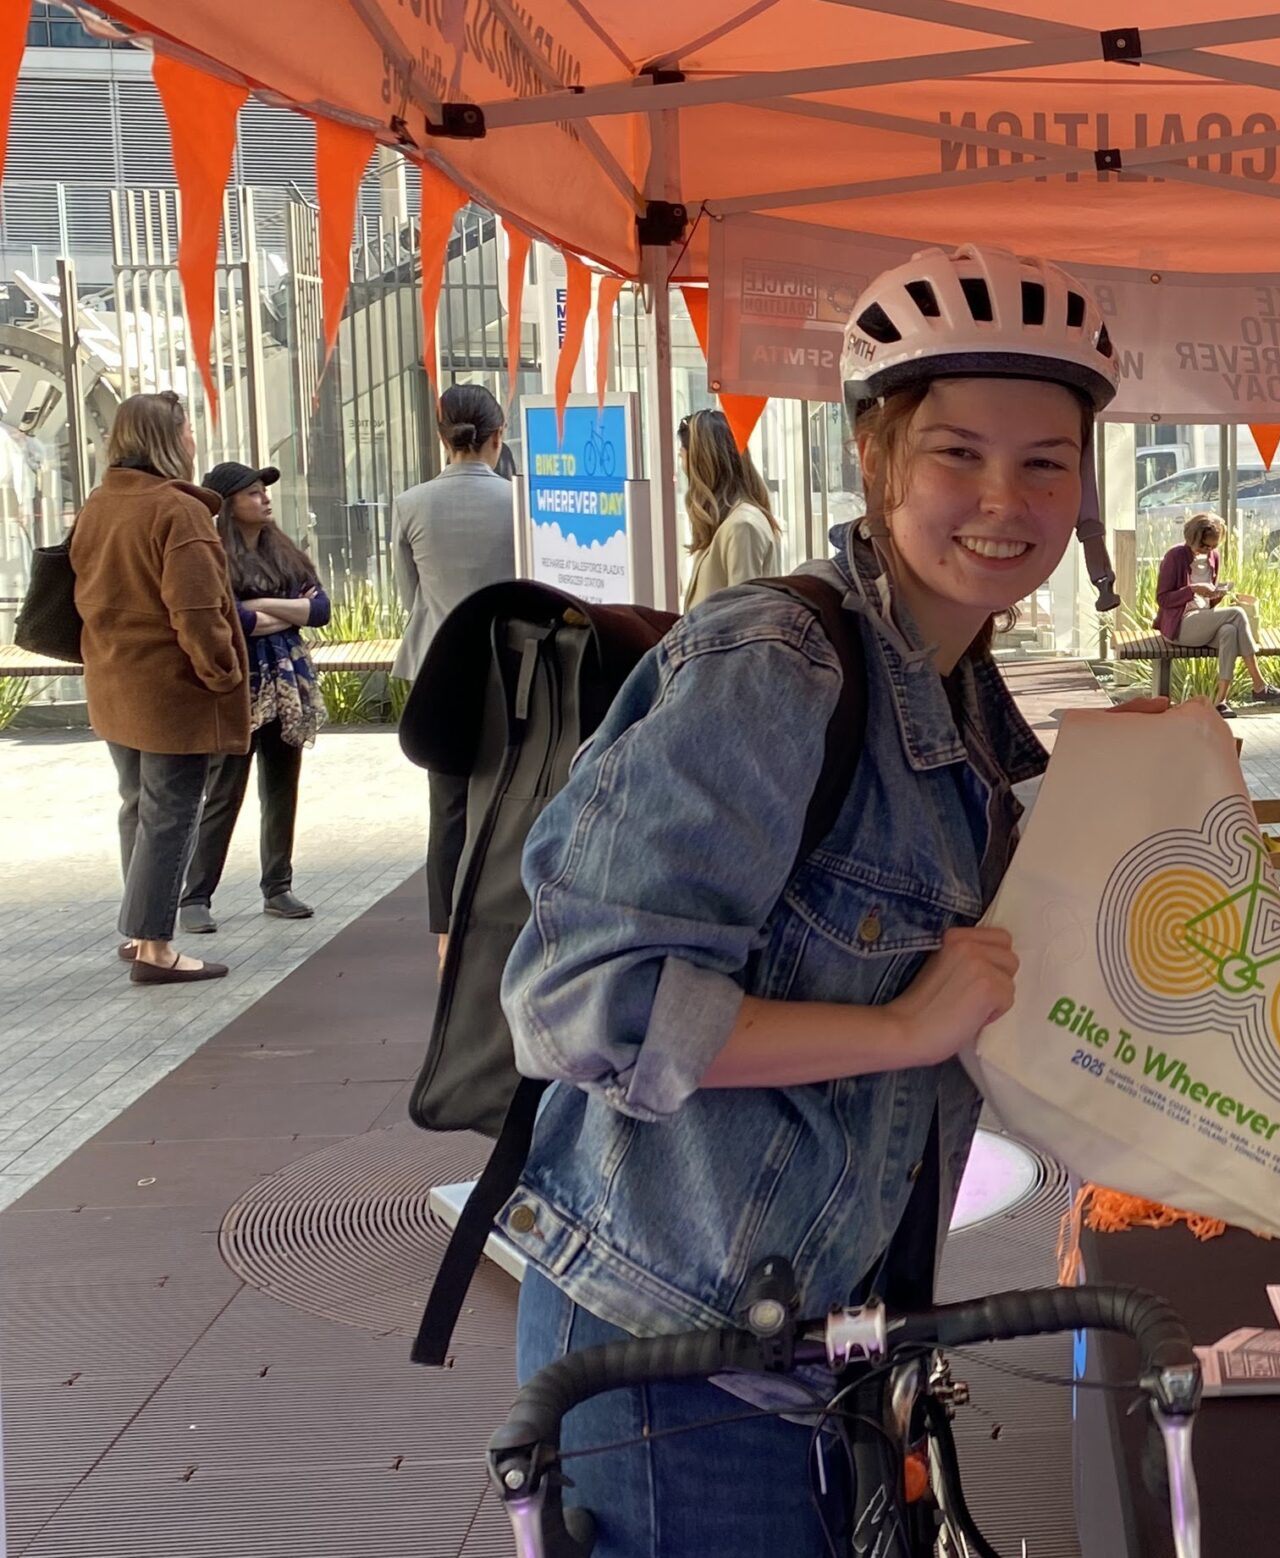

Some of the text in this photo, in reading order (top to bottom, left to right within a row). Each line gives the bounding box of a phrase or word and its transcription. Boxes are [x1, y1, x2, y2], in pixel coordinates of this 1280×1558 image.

[536, 454, 576, 477] BIKE TO
[537, 489, 625, 516] WHEREVER DAY
[1048, 996, 1109, 1048] Bike
[1114, 1028, 1136, 1064] To
[1143, 1045, 1280, 1140] Wherever
[1071, 1049, 1106, 1077] 2025
[1143, 1096, 1165, 1112] SANTA
[1167, 1109, 1190, 1125] CLARA
[1198, 1125, 1228, 1146] SOLANO
[1169, 1100, 1191, 1116] COSTA
[1199, 1116, 1223, 1133] MARIN
[1230, 1132, 1249, 1146] NAPA
[1257, 1145, 1271, 1158] SAN
